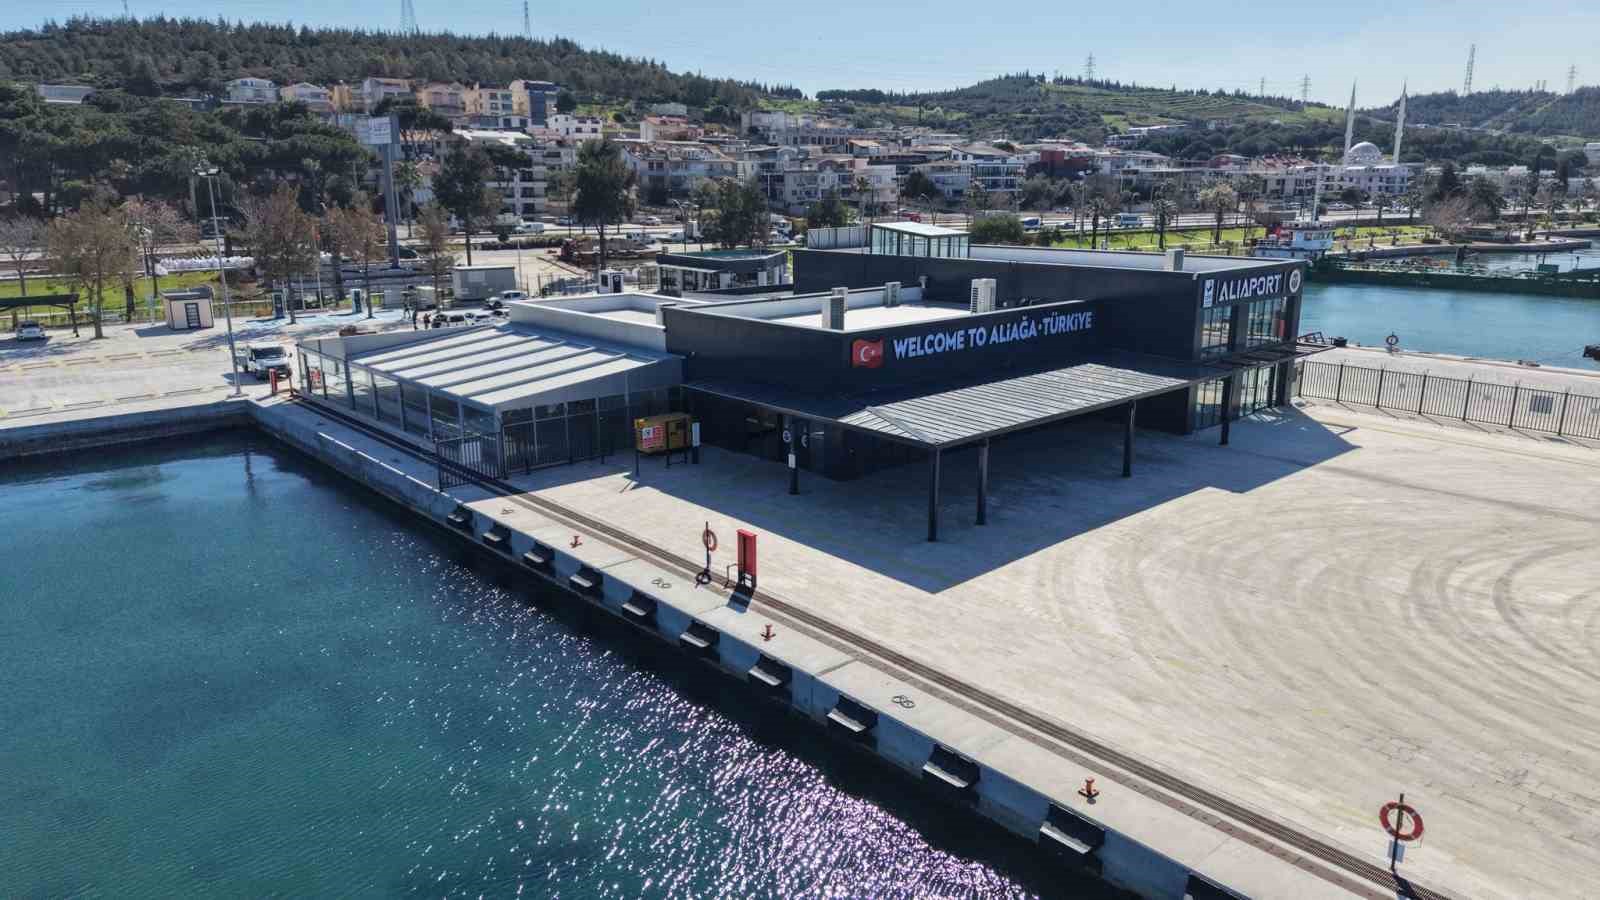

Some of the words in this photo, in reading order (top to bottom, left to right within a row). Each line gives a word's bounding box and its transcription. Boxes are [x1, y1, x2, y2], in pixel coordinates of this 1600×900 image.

[1219, 275, 1281, 301] ALIAPORT
[893, 330, 965, 360] WELCOME
[968, 326, 986, 348] TO
